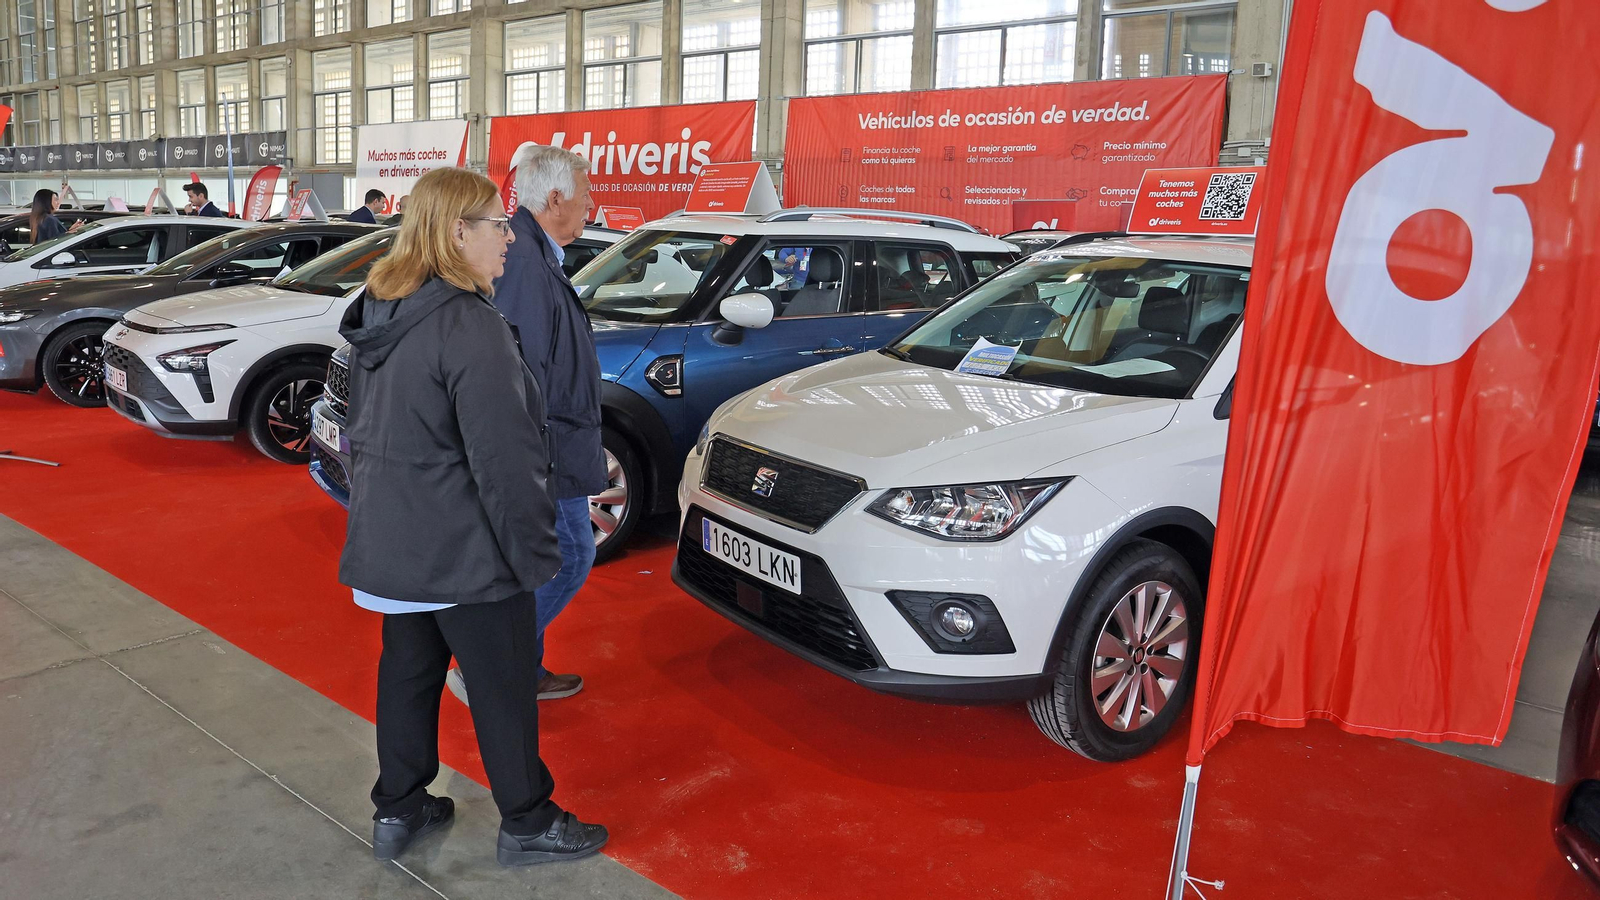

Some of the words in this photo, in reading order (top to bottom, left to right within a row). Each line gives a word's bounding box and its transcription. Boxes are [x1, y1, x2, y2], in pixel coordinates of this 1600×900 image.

[858, 111, 934, 130] Vehículos
[938, 109, 961, 127] de
[965, 106, 1035, 126] ocasión
[1041, 105, 1066, 124] de
[1072, 100, 1150, 123] verdad.
[968, 144, 977, 152] La
[978, 144, 1000, 154] mejor
[1002, 144, 1036, 154] garantía
[1103, 142, 1131, 150] Precio
[1133, 141, 1167, 150] mínimo
[368, 149, 397, 162] Muchos
[398, 148, 416, 161] más
[418, 147, 447, 160] coches
[1102, 153, 1156, 164] garantizado
[890, 156, 916, 166] quieras
[379, 168, 389, 178] en
[612, 184, 620, 192] DE
[622, 182, 656, 192] OCASIÓN
[658, 184, 670, 192] DE
[672, 184, 693, 192] VERD
[860, 184, 884, 193] Coches
[885, 185, 894, 193] de
[896, 186, 916, 194] todas
[1159, 180, 1195, 188] Tenemos
[964, 186, 1020, 194] Seleccionados
[1022, 188, 1028, 196] y
[1148, 190, 1179, 198] muchos
[1180, 190, 1198, 198] más
[1002, 197, 1010, 205] al
[1156, 200, 1184, 208] coches
[714, 528, 752, 568] 1603
[758, 547, 795, 586] LKN
